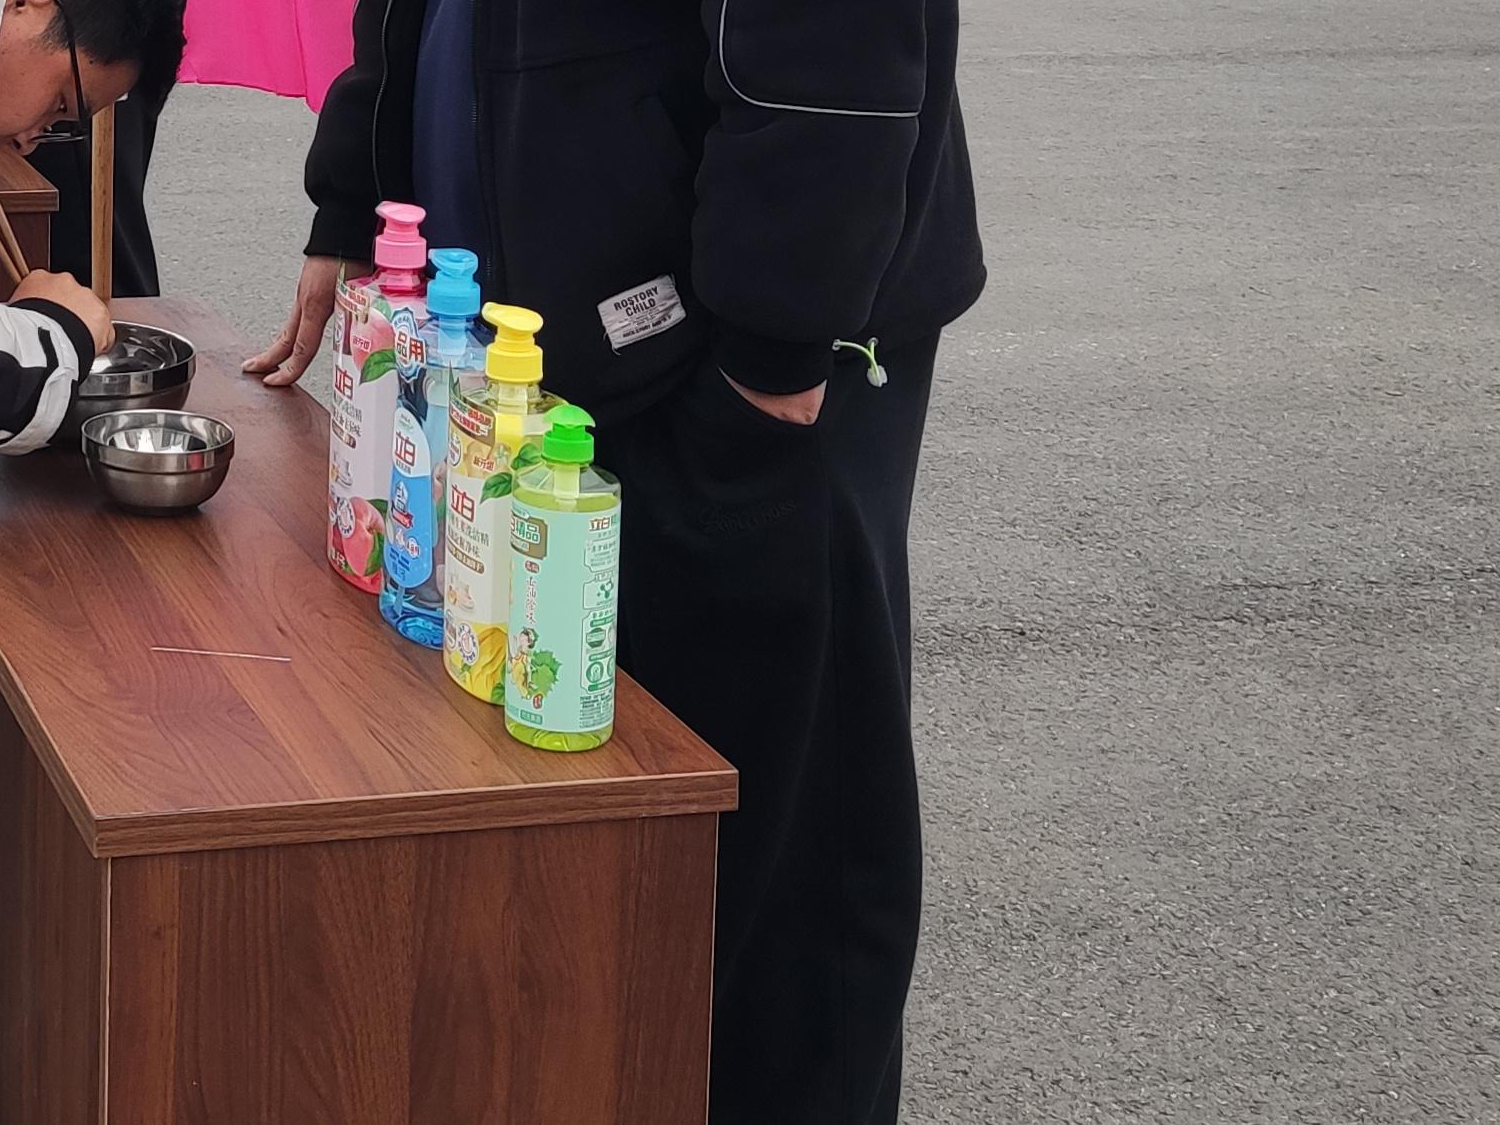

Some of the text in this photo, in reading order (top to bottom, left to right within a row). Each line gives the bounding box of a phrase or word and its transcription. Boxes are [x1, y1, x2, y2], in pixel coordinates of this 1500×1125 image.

[625, 298, 656, 317] CHILD
[394, 430, 416, 467] 立白
[451, 484, 475, 524] 立白
